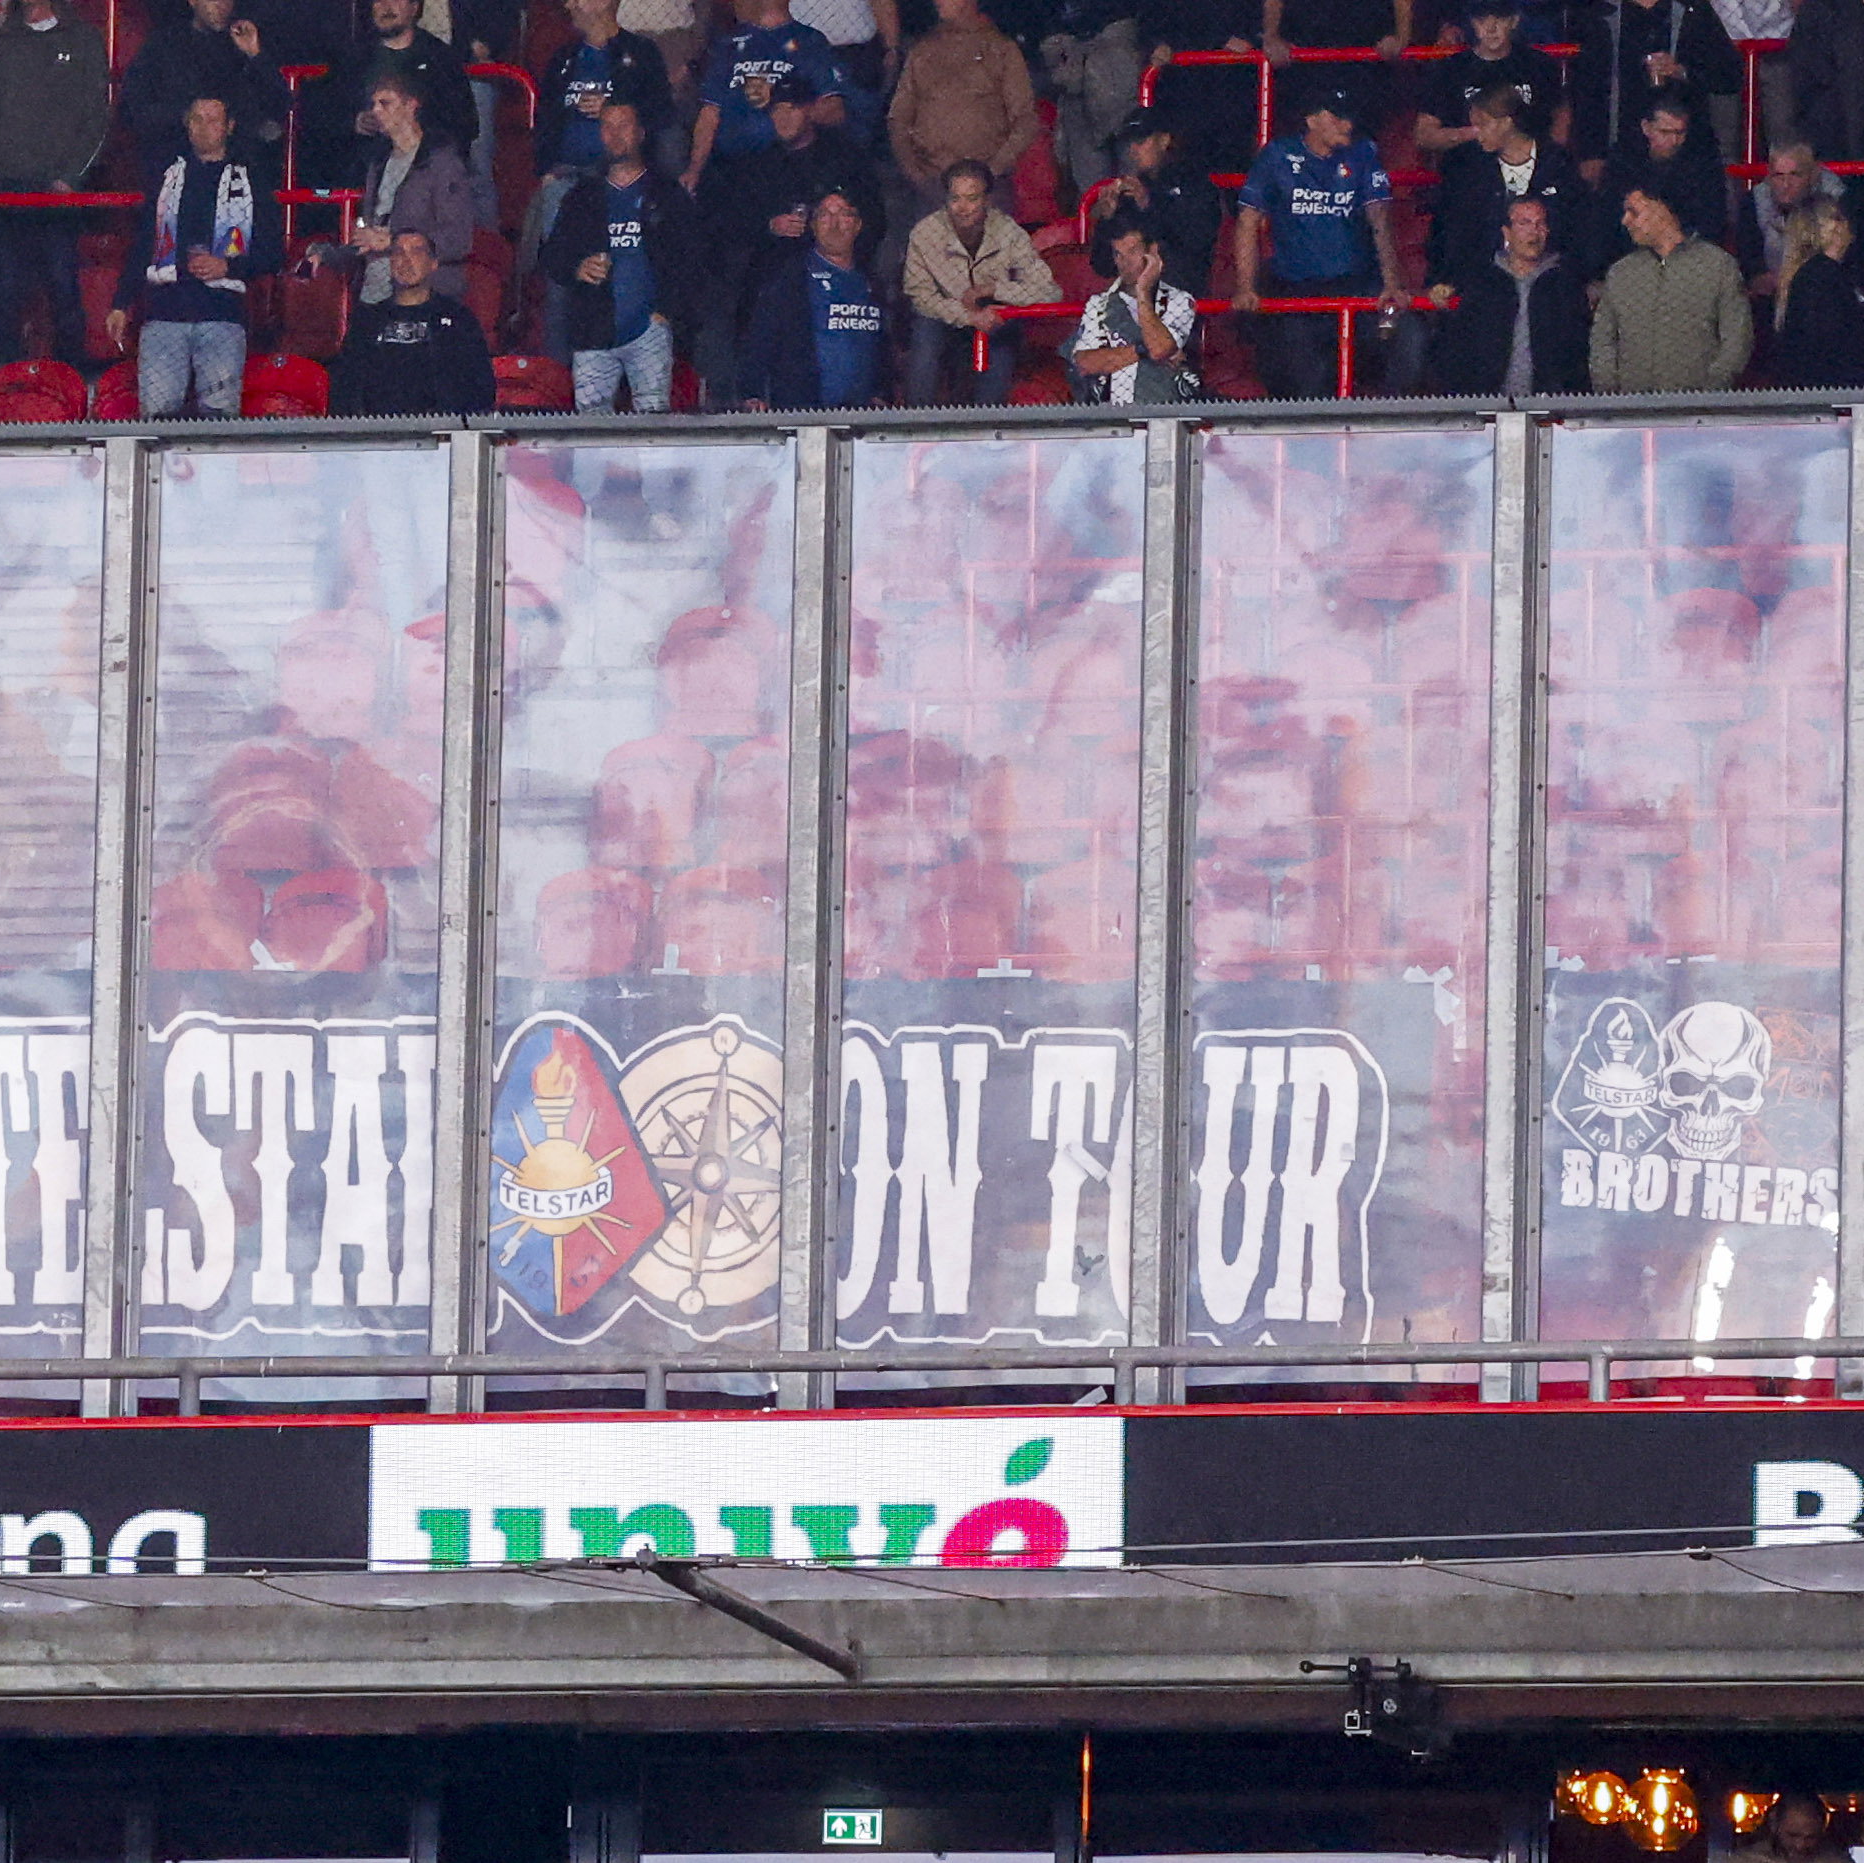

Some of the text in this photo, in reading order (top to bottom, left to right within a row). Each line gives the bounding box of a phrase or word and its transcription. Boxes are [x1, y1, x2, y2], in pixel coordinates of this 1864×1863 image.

[1291, 187, 1356, 204] PORT OF
[828, 303, 866, 317] PORT
[827, 316, 881, 331] ENERG
[1584, 1084, 1657, 1106] TELSTAR
[1030, 1044, 1362, 1325] TUR
[1560, 1148, 1840, 1229] BROTHERS
[501, 1179, 611, 1218] TELSTAR
